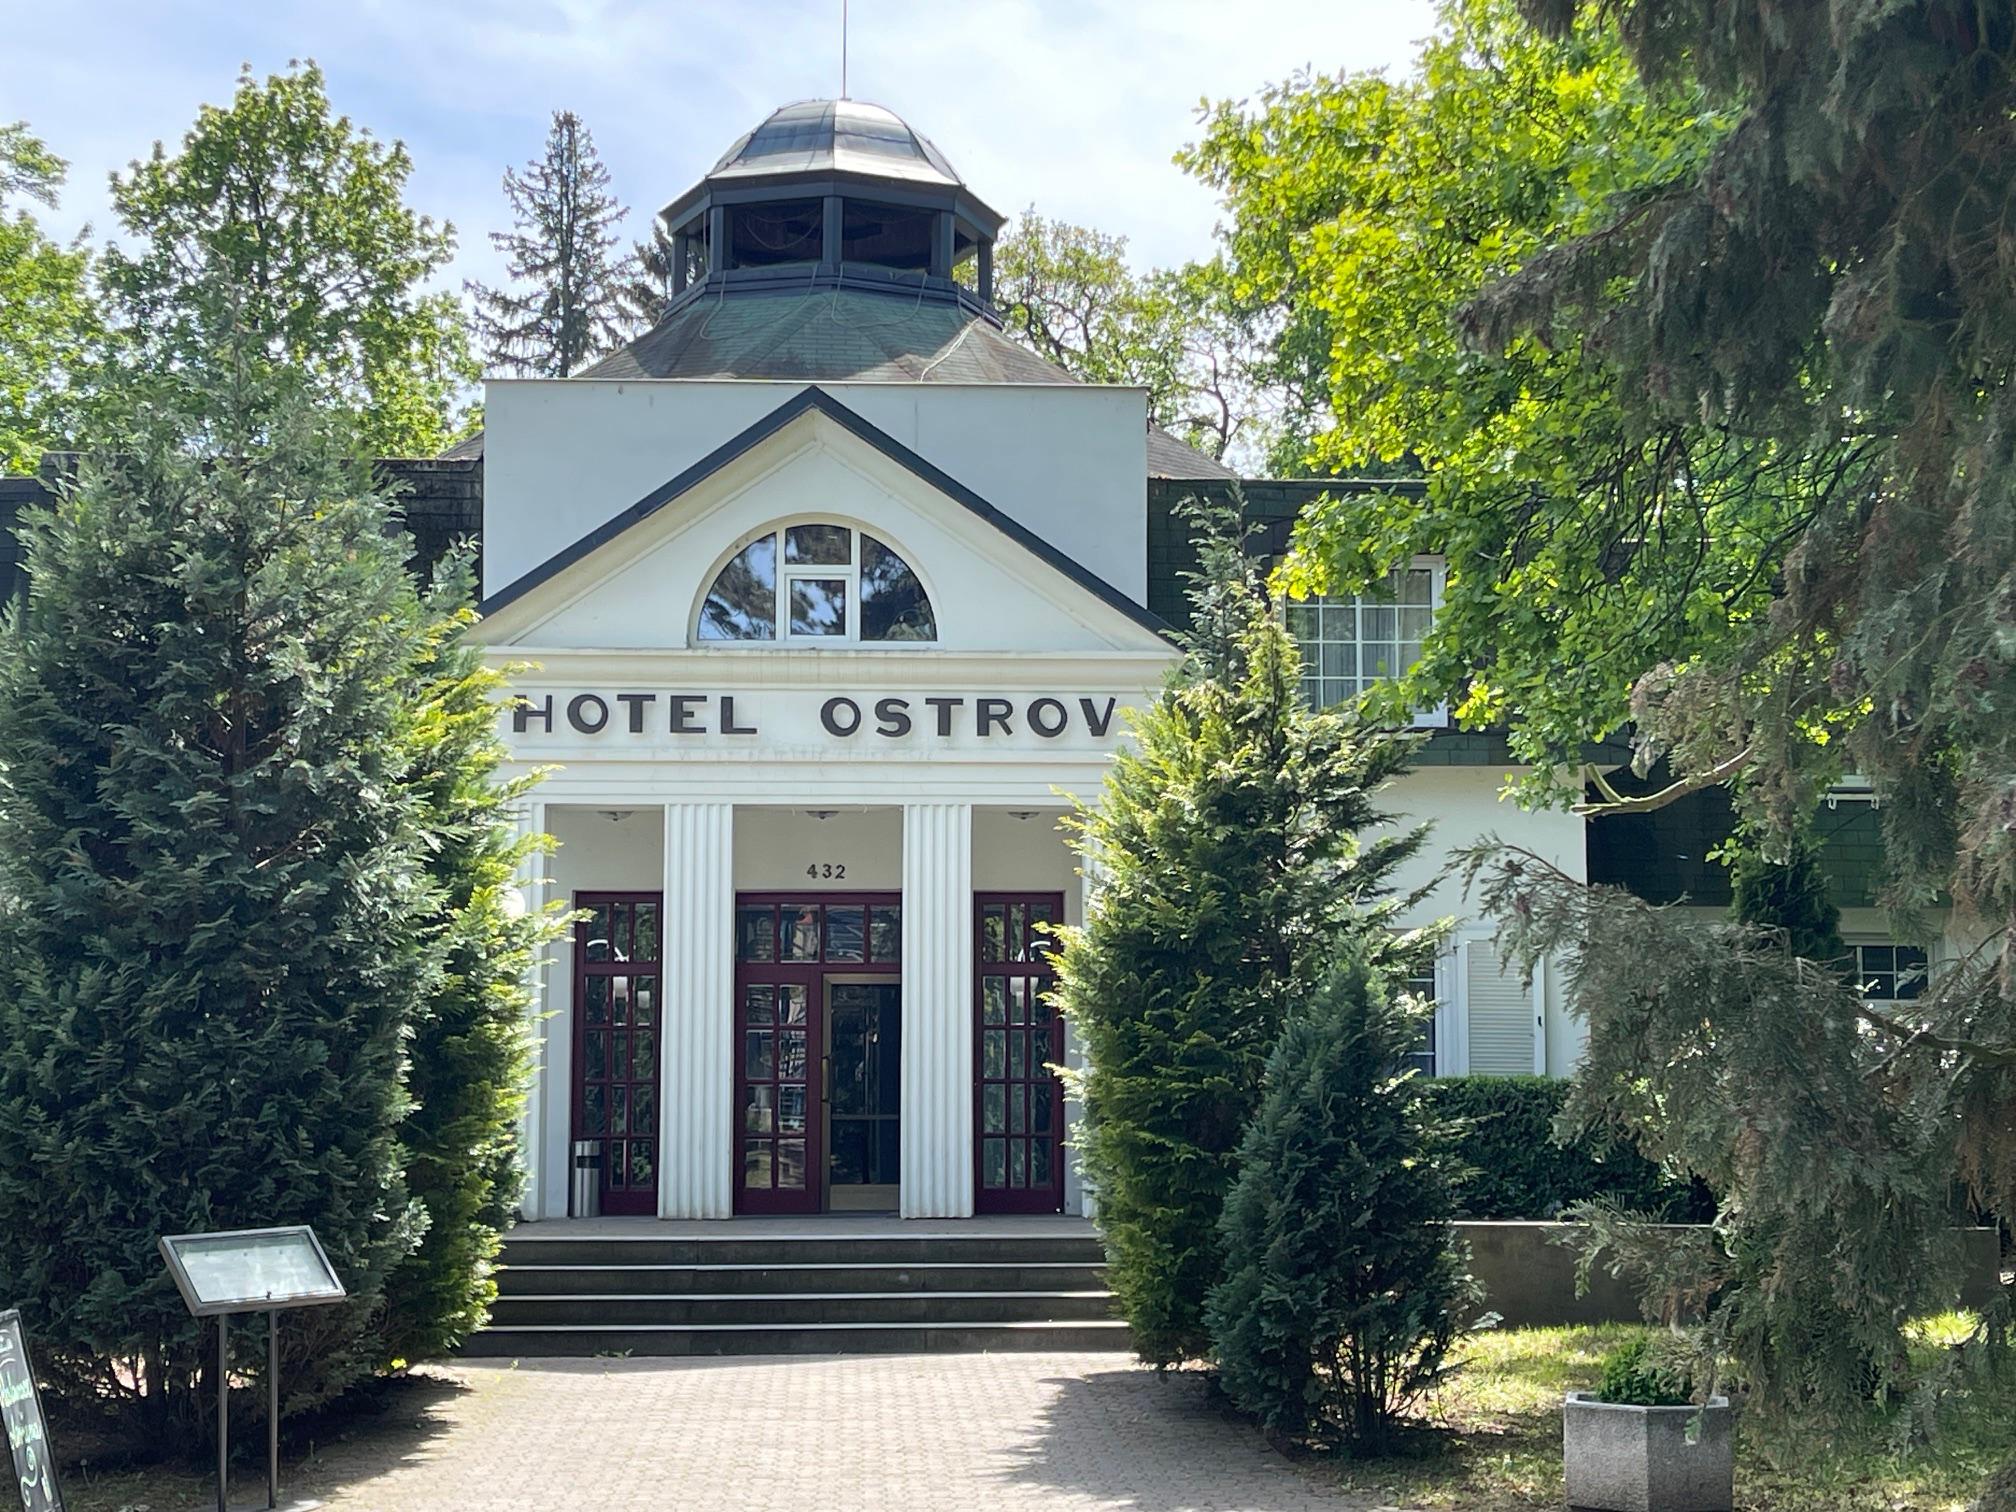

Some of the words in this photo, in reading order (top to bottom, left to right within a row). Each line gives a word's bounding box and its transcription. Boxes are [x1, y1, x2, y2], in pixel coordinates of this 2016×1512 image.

[513, 694, 757, 735] HOTEL
[820, 697, 1116, 738] OSTROV
[806, 863, 846, 880] 432
